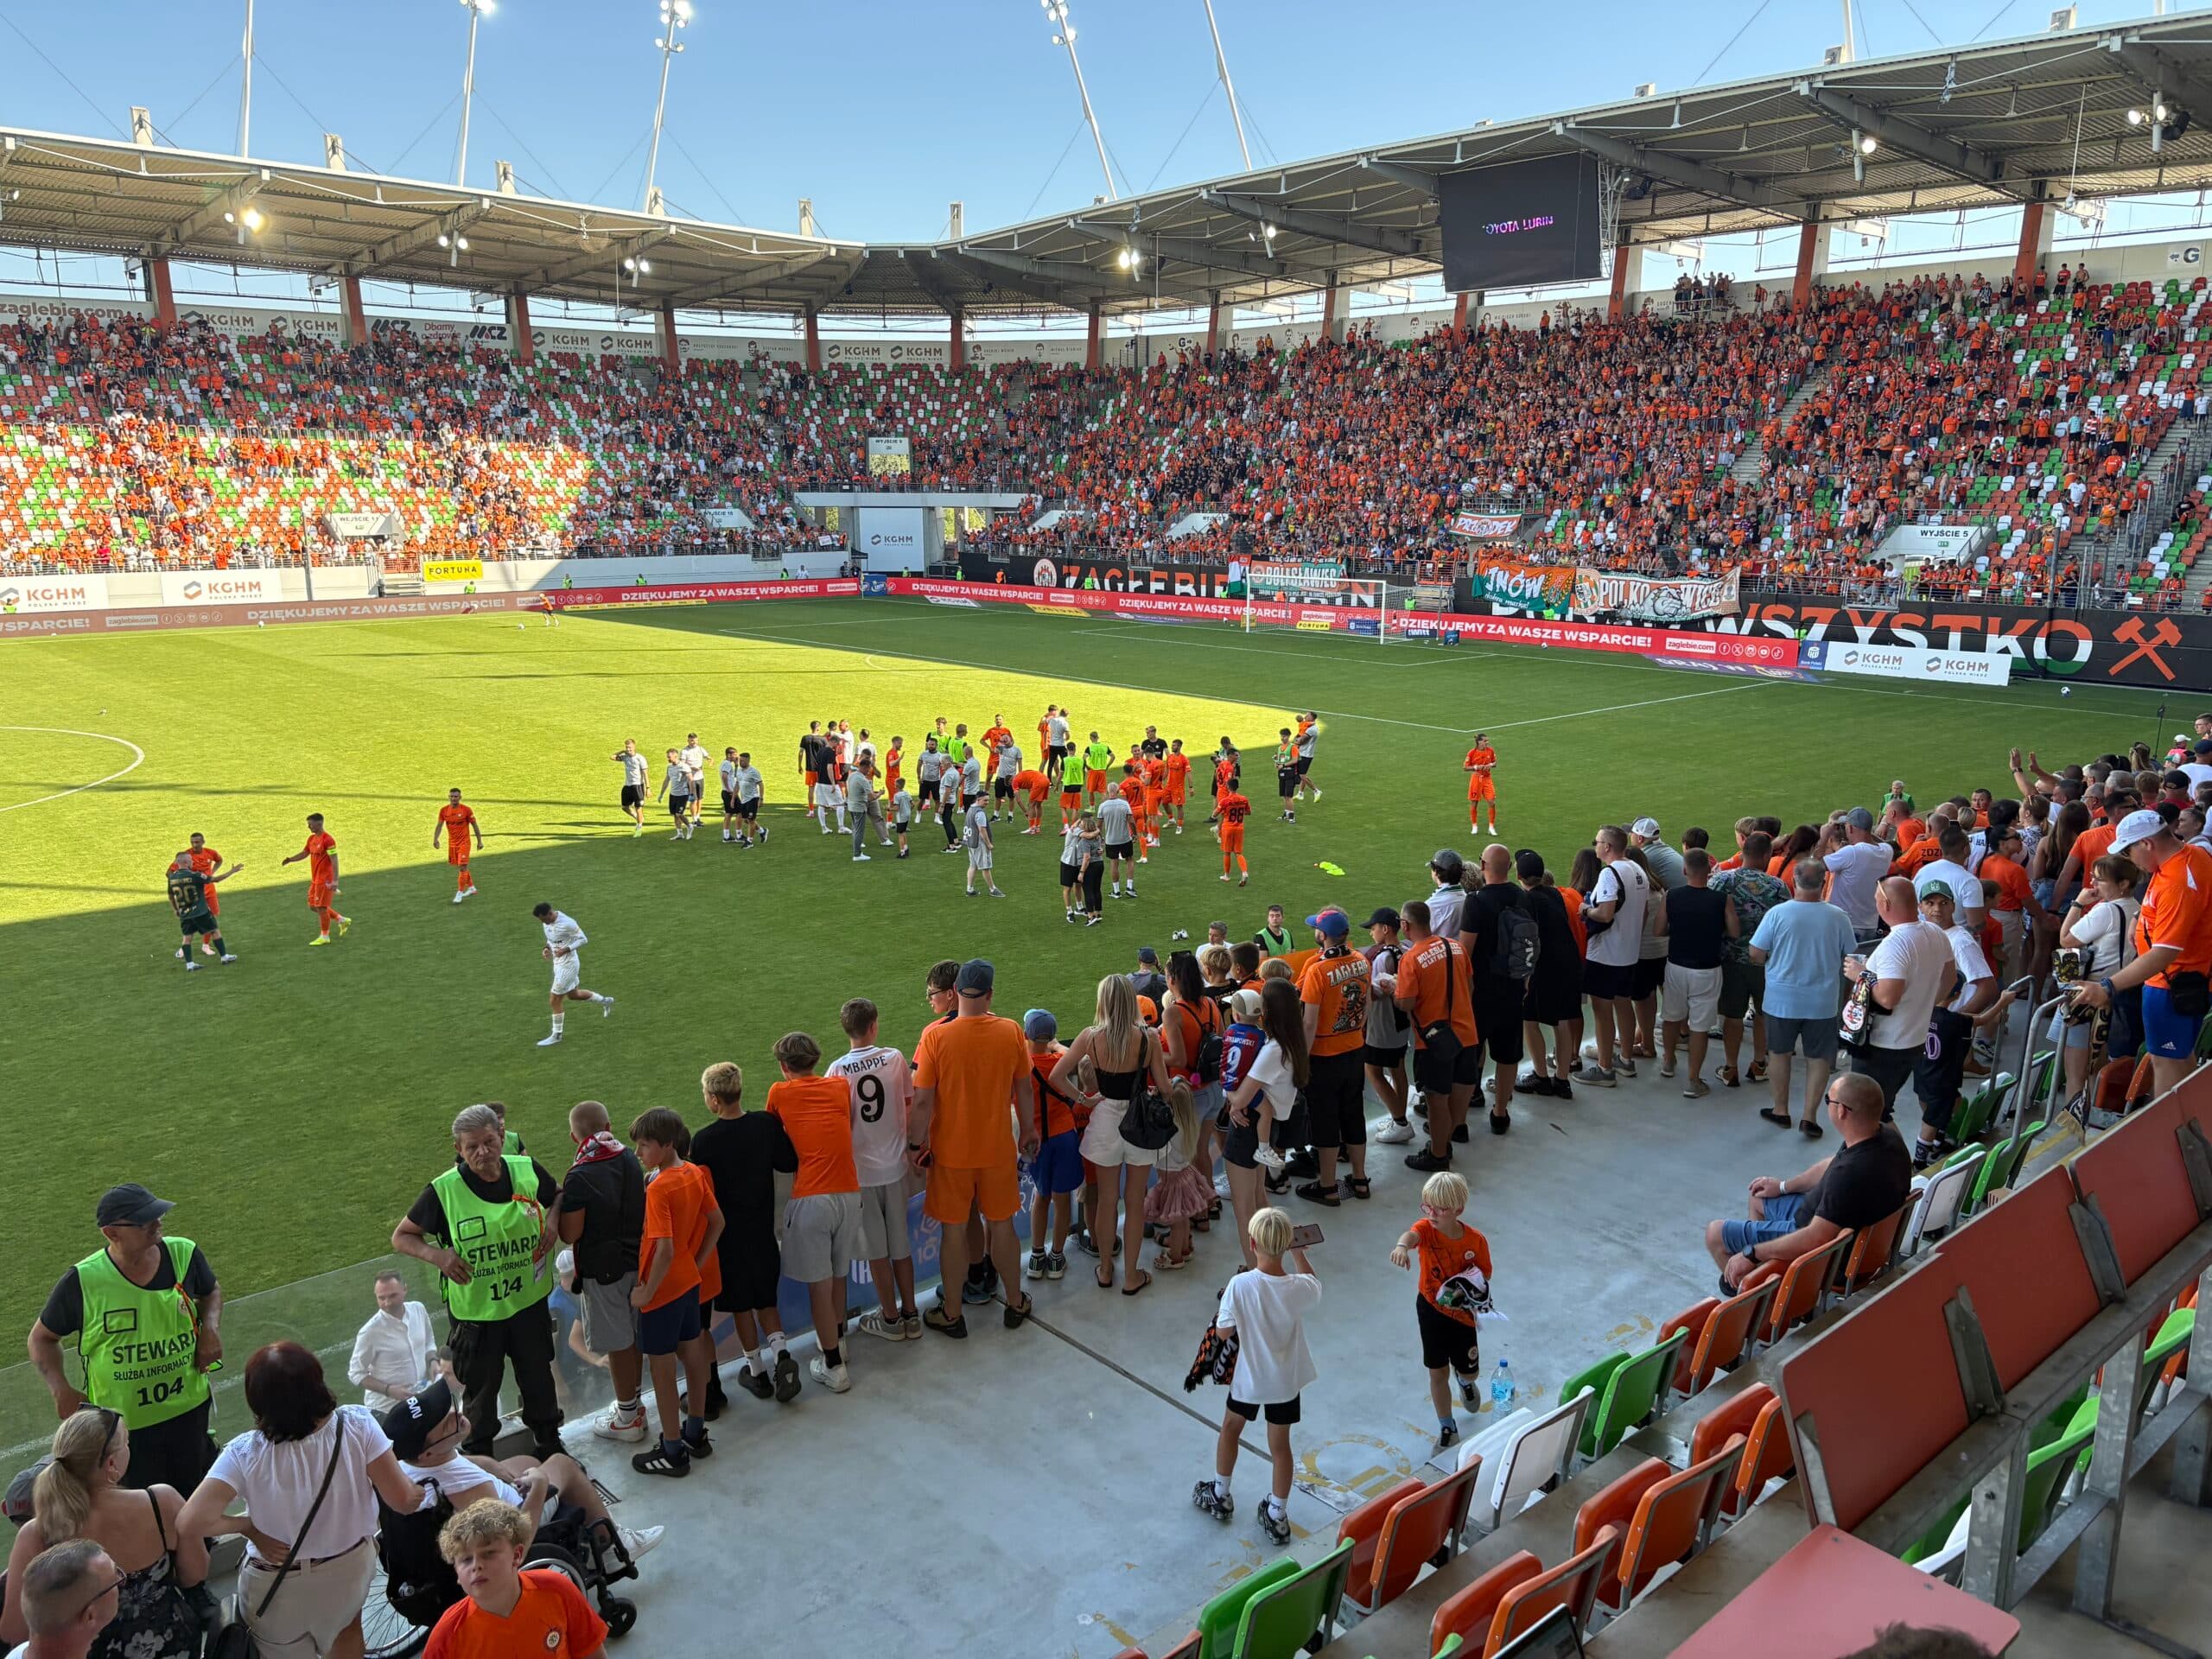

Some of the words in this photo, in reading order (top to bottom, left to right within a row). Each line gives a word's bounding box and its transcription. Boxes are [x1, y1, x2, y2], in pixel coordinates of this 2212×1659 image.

[1483, 221, 1519, 234] OYOTA
[2183, 248, 2200, 264] G
[207, 314, 254, 327] KGHM
[292, 319, 338, 332] KGHM
[553, 334, 589, 346] KGHM
[617, 338, 652, 349] KGHM
[844, 346, 880, 356] KGHM
[906, 347, 942, 357] KGHM
[1921, 528, 1959, 537] WYJŚCIE
[429, 566, 477, 575] FORTUNA
[208, 581, 261, 594] KGHM
[759, 585, 818, 594] WSPARCIE!
[970, 587, 998, 597] WASZE
[1000, 589, 1044, 601] WSPARCIE!
[27, 588, 86, 601] KGHM
[248, 607, 347, 620] DZIĘKUJEMY
[351, 606, 370, 614] ZA
[373, 602, 426, 613] WASZE
[1119, 599, 1178, 611] DZIĘKUJEMY
[1179, 603, 1193, 612] ZA
[1194, 603, 1230, 614] WASZE
[1232, 607, 1292, 619] WSPARCIE!
[1485, 623, 1505, 636] ZA
[1509, 626, 1562, 641] WASZE
[1565, 629, 1651, 648] WSPARCIE!
[1668, 641, 1715, 651] zaglebie.com
[1862, 653, 1902, 665] KGHM
[1945, 660, 1989, 672] KGHM
[1229, 807, 1246, 823] 88
[1925, 1033, 1941, 1060] 0
[843, 1055, 887, 1076] MBAPPE
[1227, 1046, 1241, 1072] 9
[856, 1075, 885, 1122] 9
[473, 1268, 496, 1279] ŁUŻBA
[490, 1276, 524, 1301] 124
[113, 1370, 145, 1381] SŁUŻBA
[147, 1354, 193, 1376] INFORMACY
[137, 1376, 184, 1407] 104
